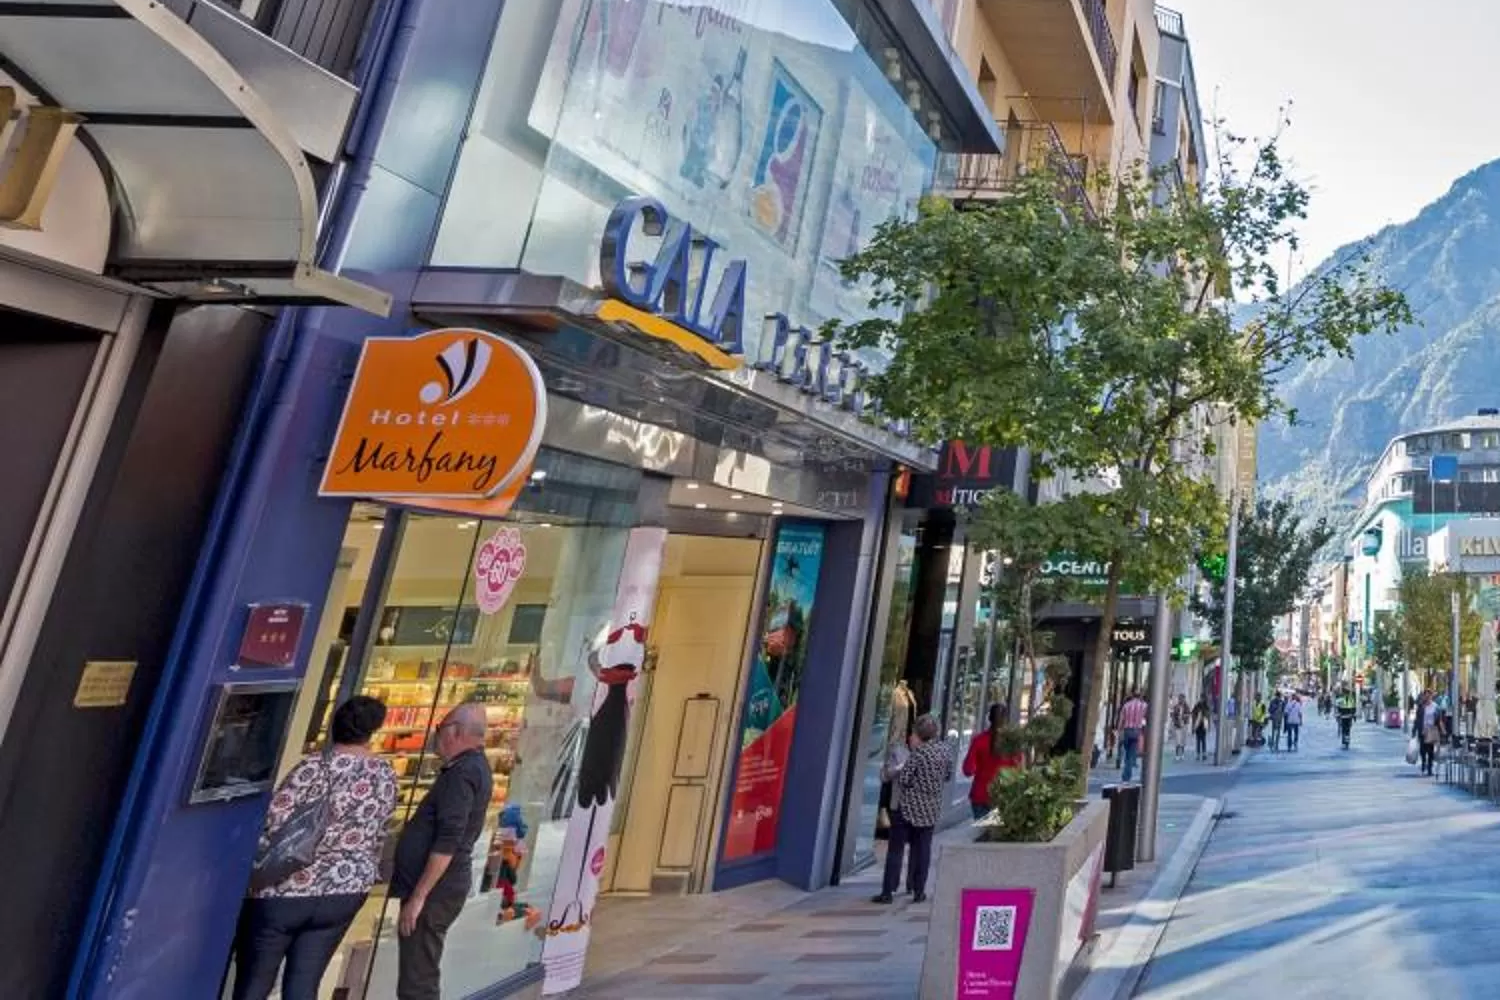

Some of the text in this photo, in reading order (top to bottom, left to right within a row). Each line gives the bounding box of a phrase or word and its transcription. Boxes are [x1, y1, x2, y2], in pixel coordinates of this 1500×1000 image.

[600, 195, 746, 354] GALA
[370, 409, 460, 426] Hotel
[336, 429, 497, 490] Marfany
[940, 440, 992, 479] M
[1113, 629, 1145, 641] TOUS
